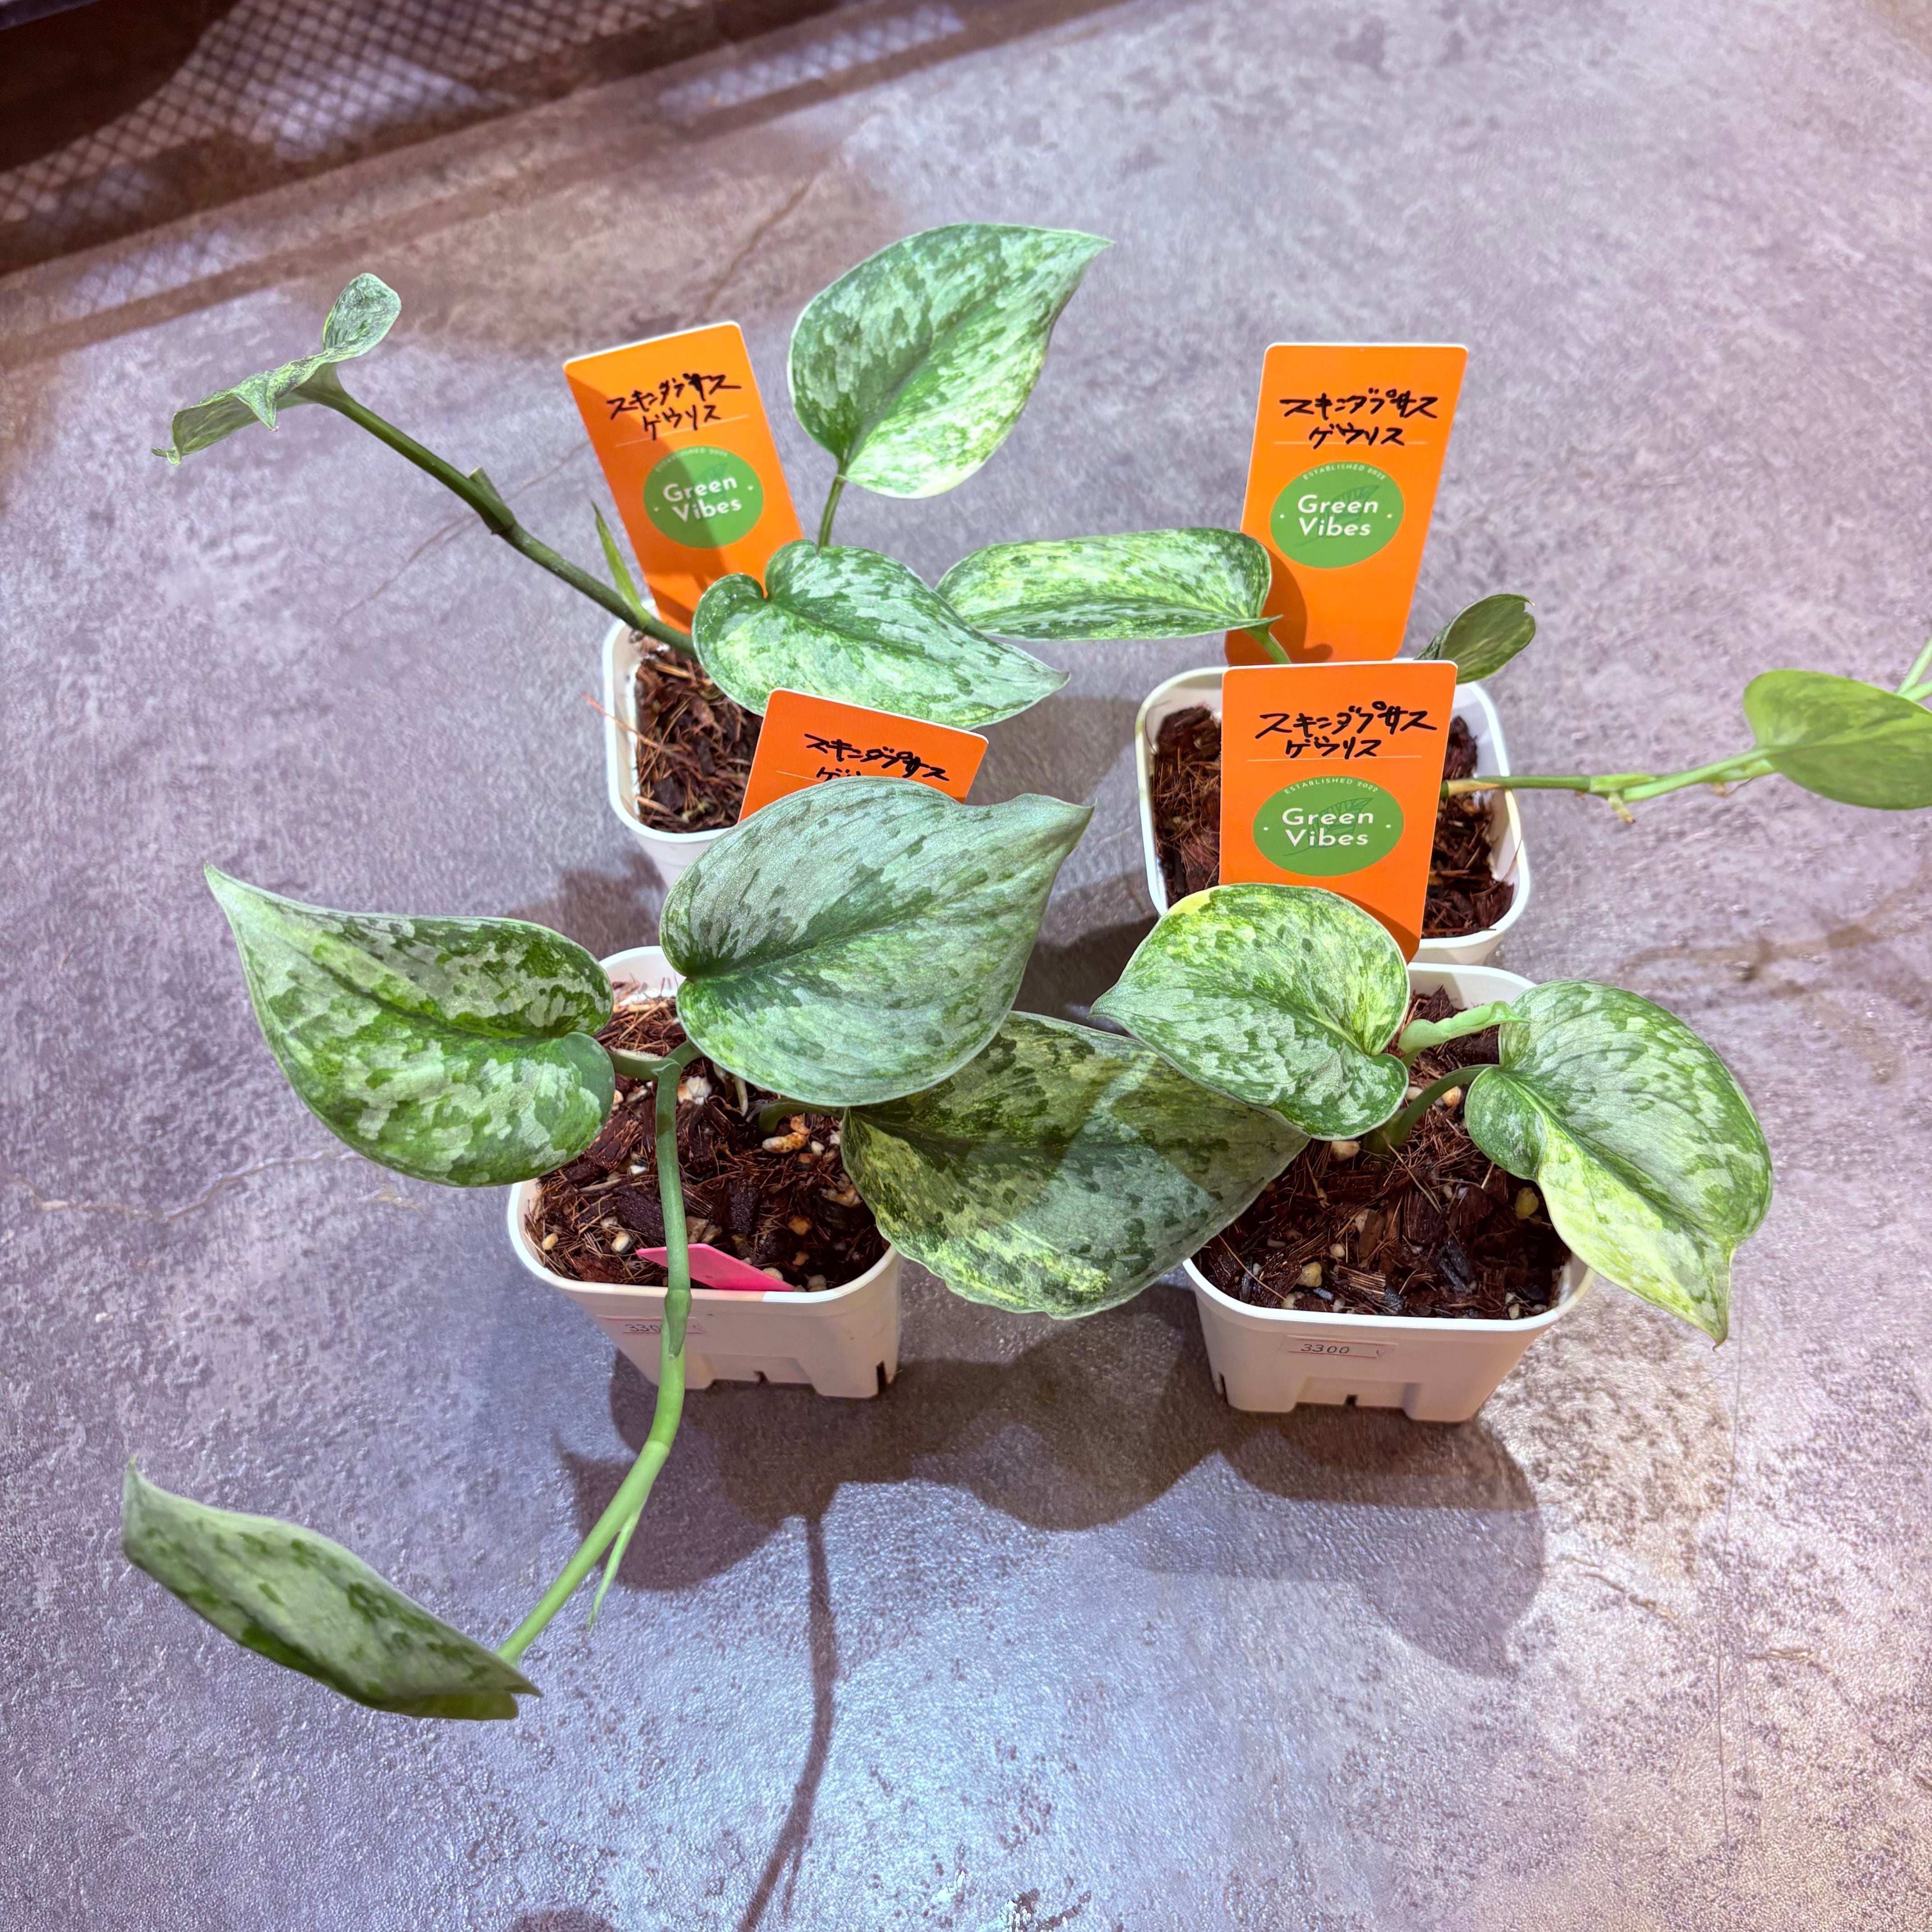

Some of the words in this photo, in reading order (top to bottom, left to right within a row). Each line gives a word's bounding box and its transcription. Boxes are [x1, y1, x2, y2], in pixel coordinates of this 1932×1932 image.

[1302, 463, 1365, 480] ESTABLISHED
[663, 476, 737, 502] Green
[671, 498, 742, 523] Vibes
[1297, 494, 1379, 514] Green
[1298, 516, 1371, 536] Vibes
[1283, 777, 1353, 795] ESTABLISHED
[1282, 808, 1374, 826] Green
[1285, 828, 1368, 847] Vibes
[1300, 1343, 1350, 1354] 3300
